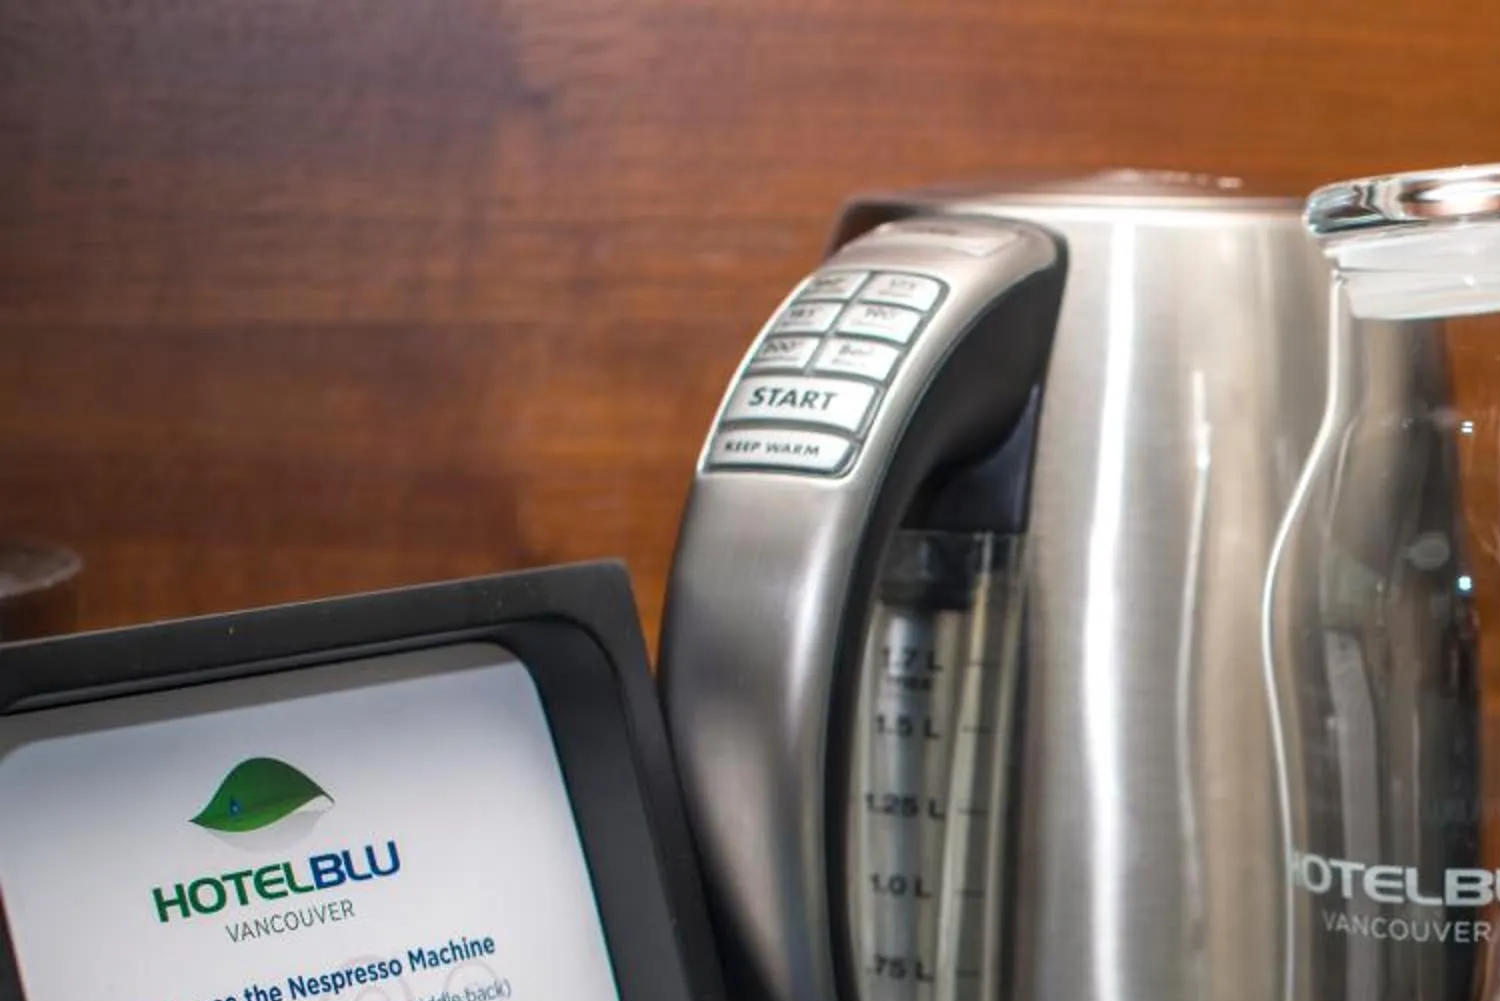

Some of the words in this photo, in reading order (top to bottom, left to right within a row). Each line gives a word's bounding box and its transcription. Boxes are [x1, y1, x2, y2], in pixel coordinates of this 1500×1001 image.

[748, 387, 838, 411] START
[724, 440, 762, 454] KEEP
[766, 442, 820, 457] WARM
[928, 651, 943, 672] L
[925, 717, 941, 738] L
[865, 793, 919, 817] 1.25
[928, 799, 945, 820] L
[871, 873, 907, 896] 1.0
[915, 875, 933, 898] L
[225, 899, 357, 944] VANCOUVER
[1321, 909, 1493, 943] VANCOUVER
[287, 957, 403, 1000] Nespresso
[407, 936, 496, 972] Machine
[916, 960, 935, 983] L
